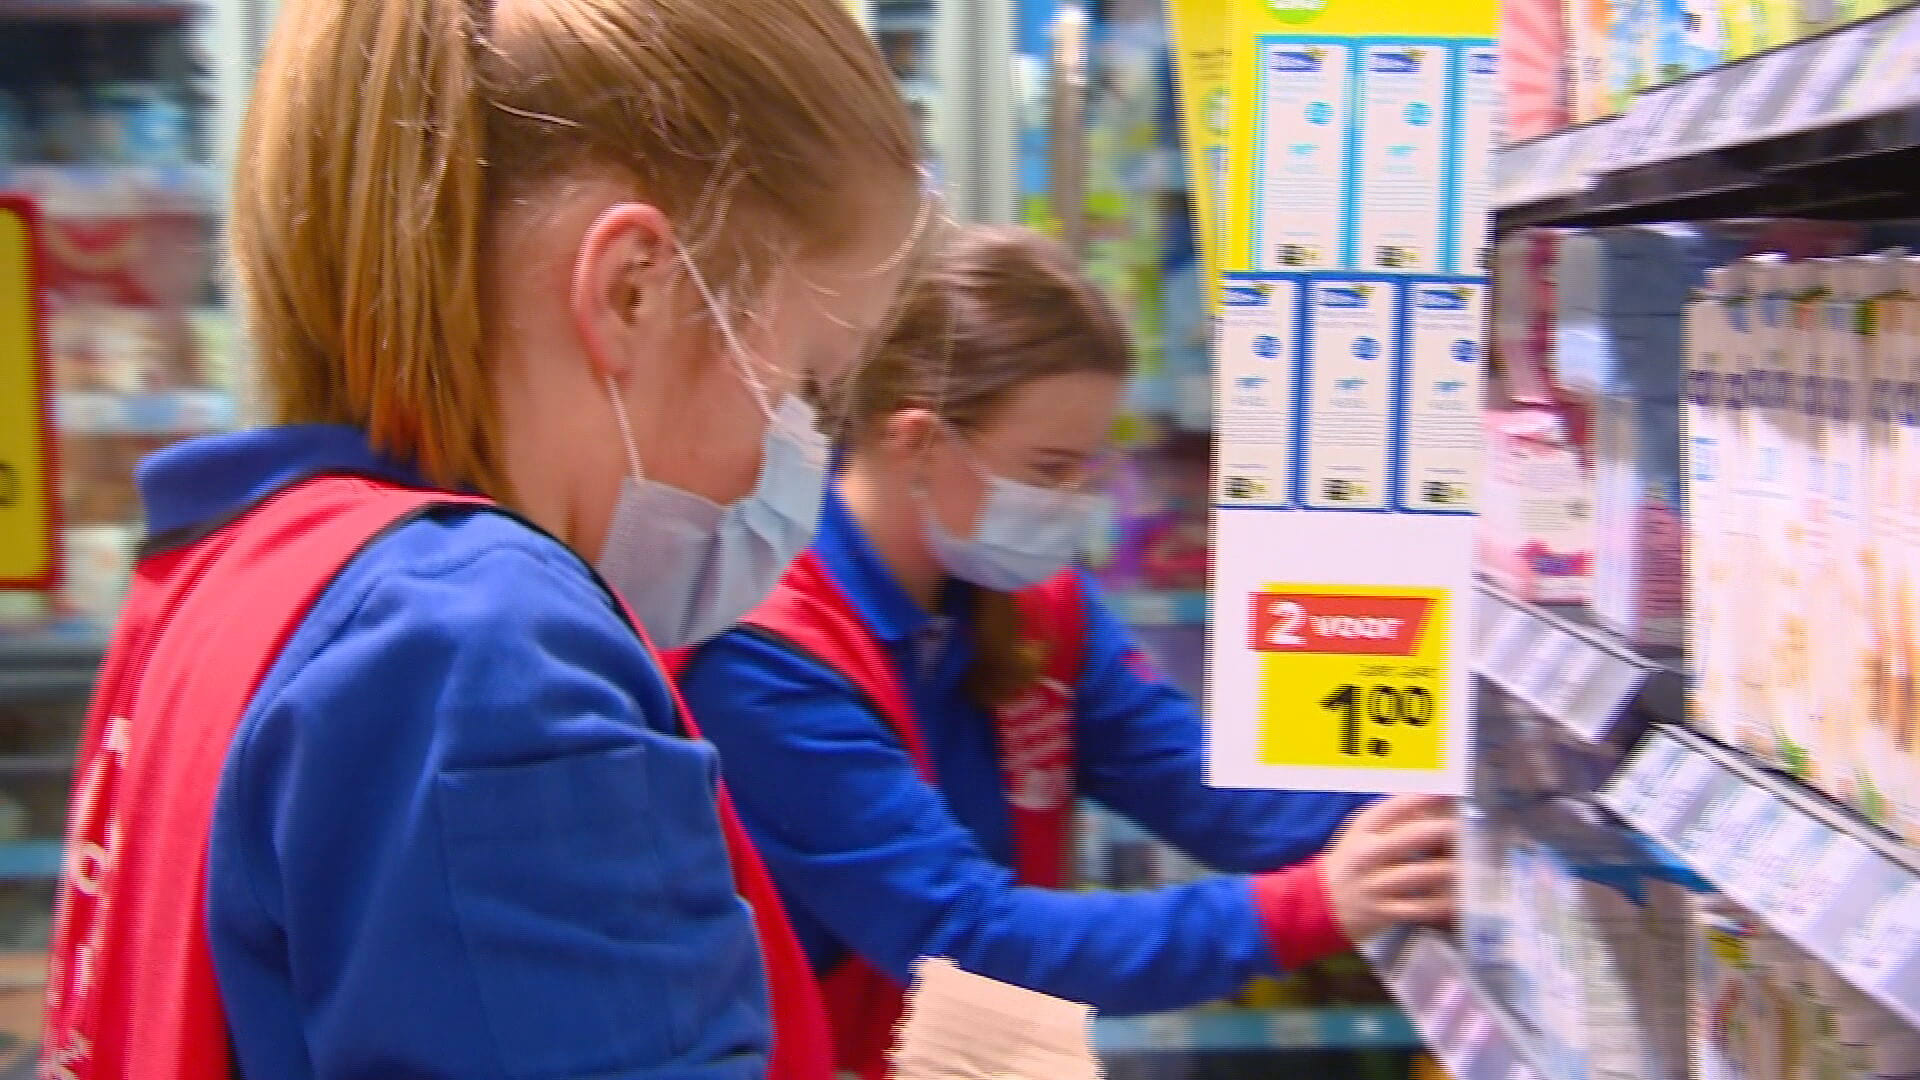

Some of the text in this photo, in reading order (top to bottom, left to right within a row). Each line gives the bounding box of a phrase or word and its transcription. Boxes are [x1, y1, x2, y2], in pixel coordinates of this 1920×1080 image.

[1265, 601, 1405, 646] 2 voor
[1318, 684, 1432, 757] 1.00
